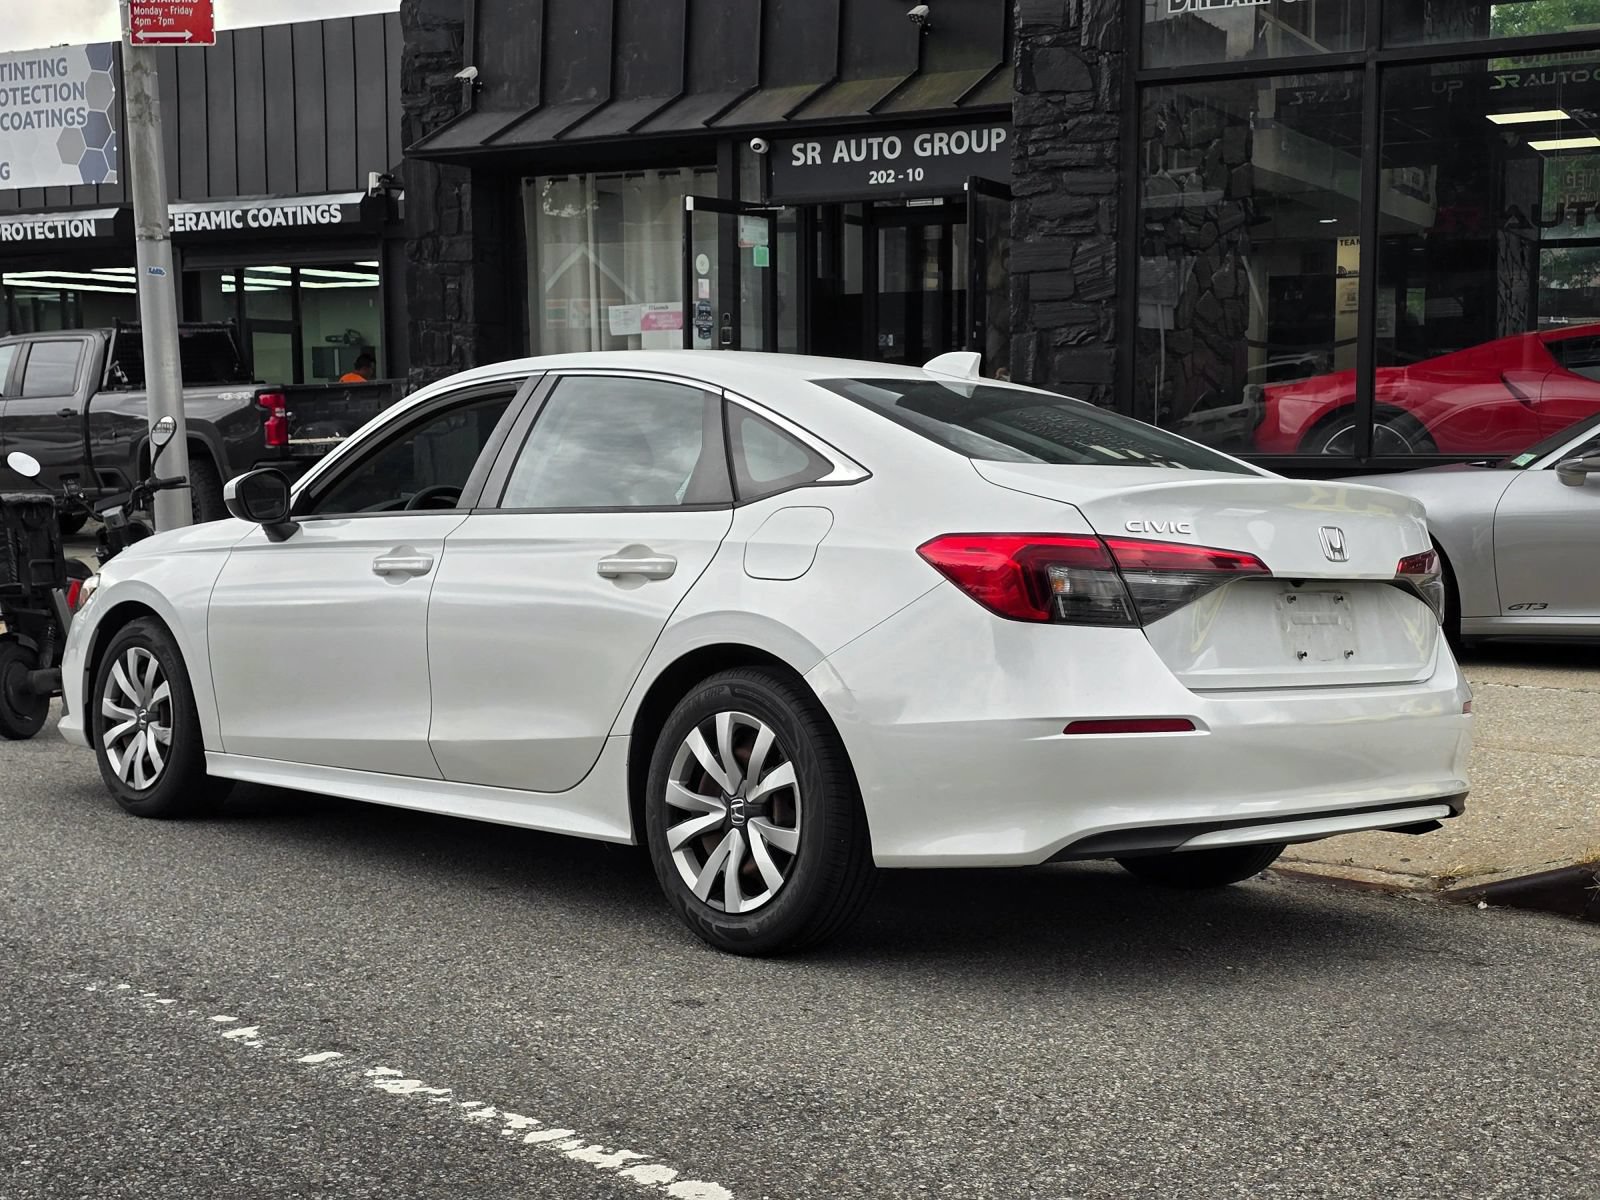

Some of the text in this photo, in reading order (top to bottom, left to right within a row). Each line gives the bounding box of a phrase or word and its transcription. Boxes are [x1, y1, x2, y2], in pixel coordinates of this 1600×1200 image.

[133, 6, 163, 16] Monday
[170, 5, 193, 17] Friday
[134, 17, 152, 26] 4pm
[158, 16, 175, 27] 7pm
[0, 57, 68, 82] TINTING
[0, 107, 87, 131] COATINGS
[791, 127, 1007, 167] SR AUTO GROUP
[868, 169, 895, 184] 202
[247, 204, 343, 229] COATINGS
[1504, 200, 1600, 229] AUT
[0, 218, 96, 241] ROTECTION
[1124, 519, 1192, 535] CIVIC
[1507, 602, 1549, 611] GT3
